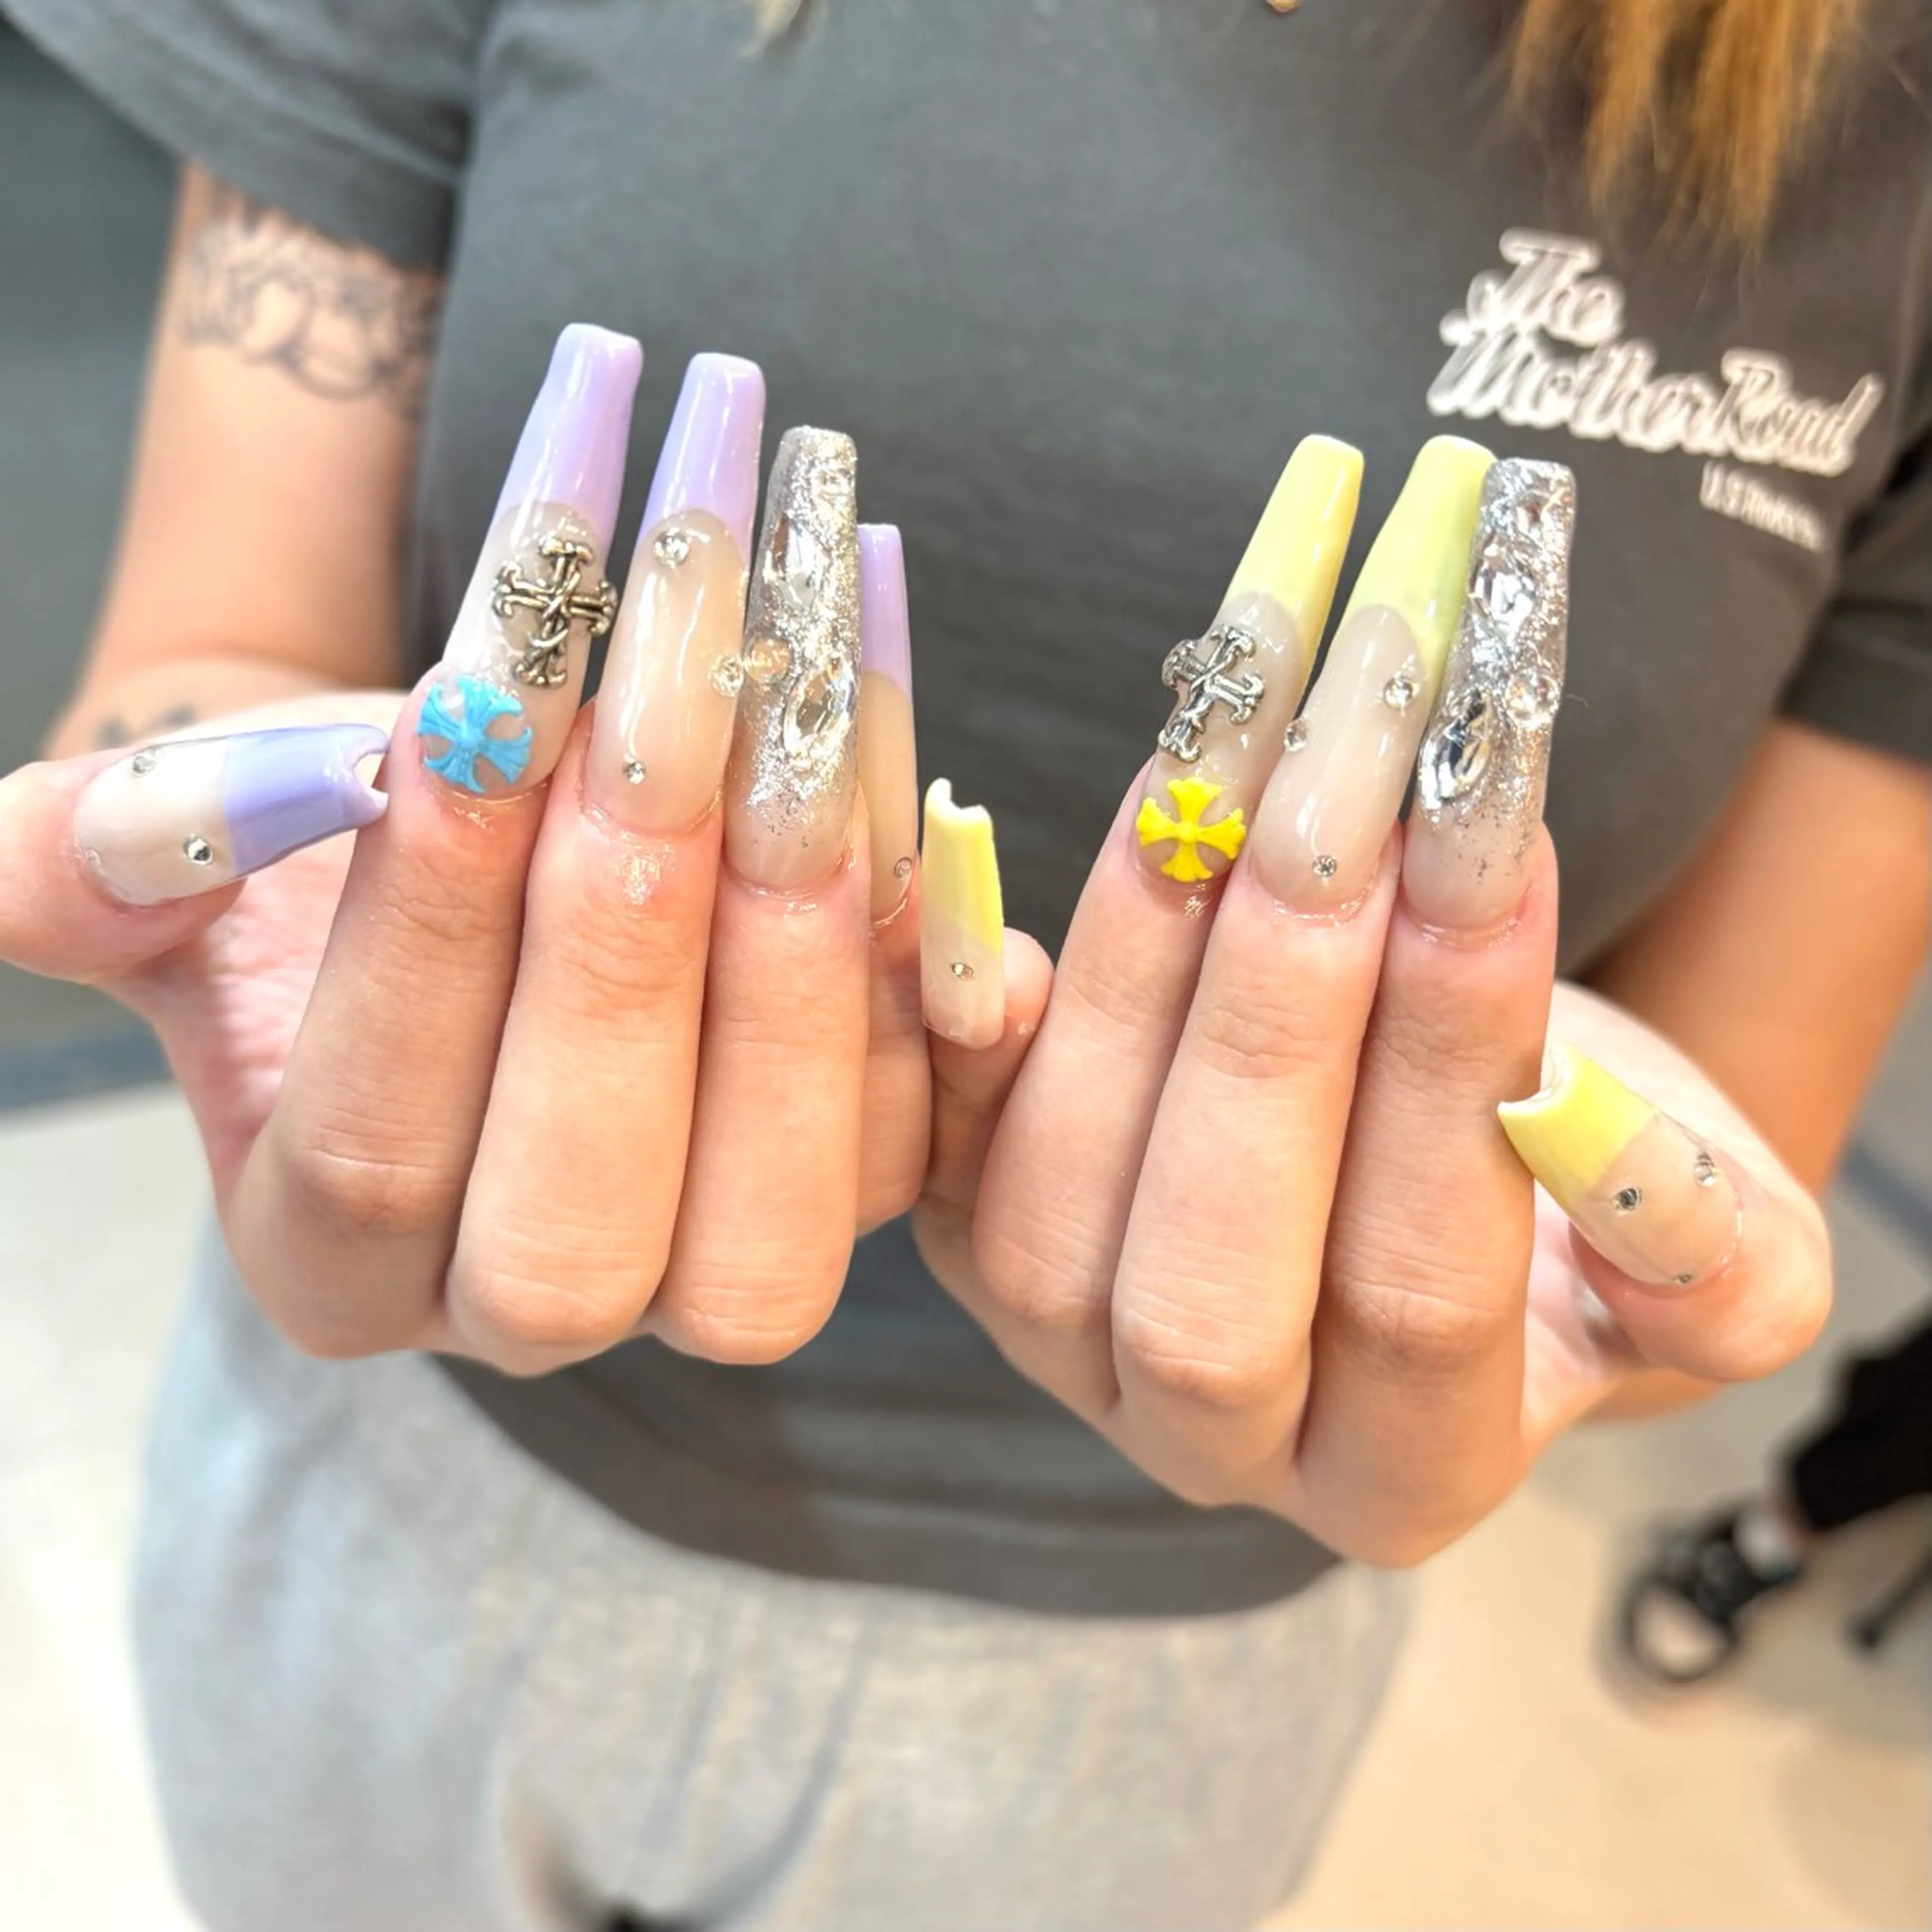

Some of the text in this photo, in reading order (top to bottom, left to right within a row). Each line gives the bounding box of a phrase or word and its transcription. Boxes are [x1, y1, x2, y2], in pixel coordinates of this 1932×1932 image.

[1468, 228, 1623, 344] The
[1427, 311, 1884, 477] Mother Road
